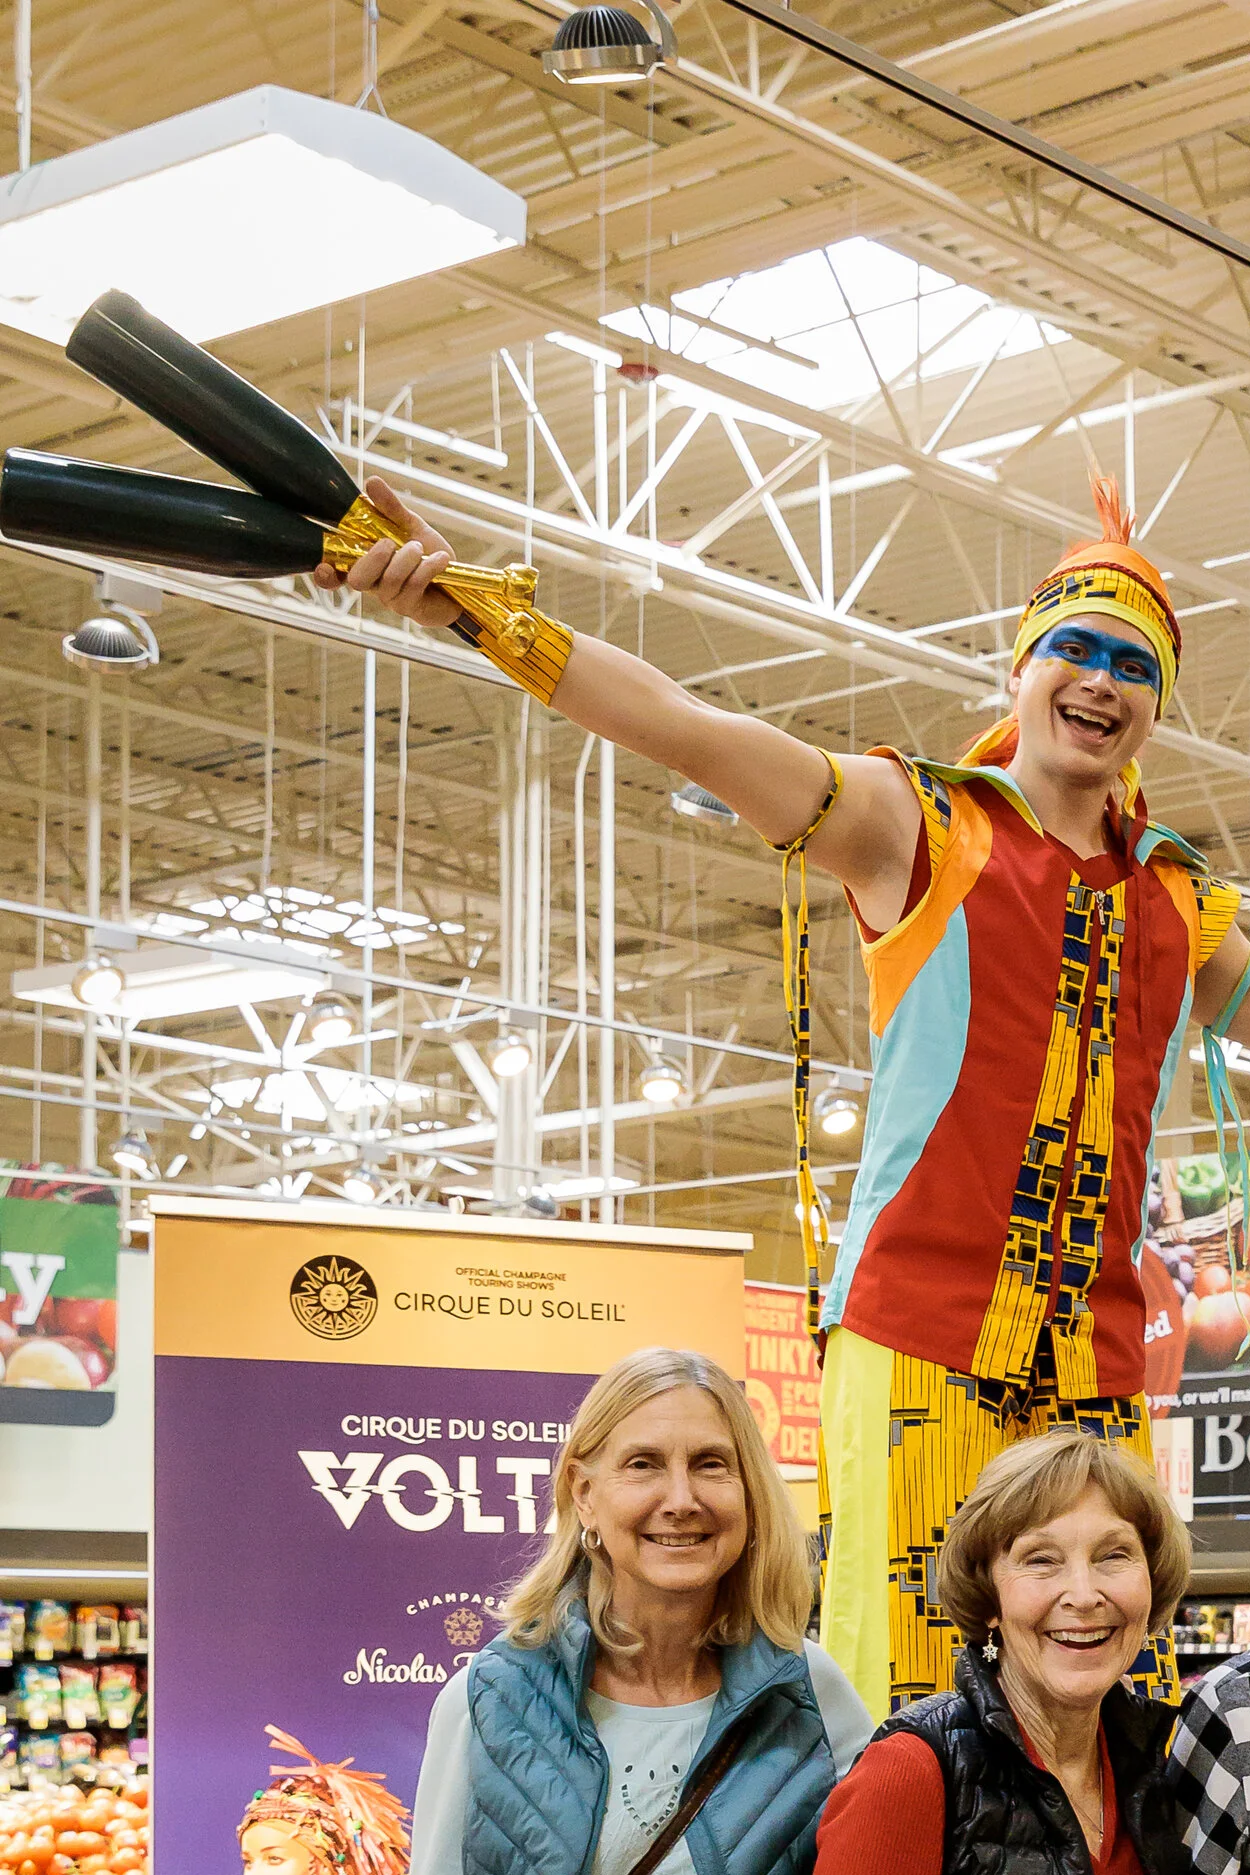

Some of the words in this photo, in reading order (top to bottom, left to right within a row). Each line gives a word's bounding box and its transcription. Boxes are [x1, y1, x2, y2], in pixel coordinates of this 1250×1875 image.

[0, 1251, 66, 1326] y
[455, 1267, 501, 1278] OFFICIAL
[503, 1270, 567, 1282] CHAMPAGNE
[468, 1277, 514, 1289] TOURING
[516, 1280, 555, 1291] SHOWS
[394, 1292, 491, 1320] CIRQUE
[500, 1298, 532, 1317] DU
[541, 1300, 626, 1322] SOLEIL
[1144, 1309, 1174, 1344] ed
[341, 1415, 442, 1445] CIRQUE
[449, 1418, 486, 1440] DU
[298, 1450, 557, 1535] VOLT
[343, 1647, 448, 1685] Nicolas
